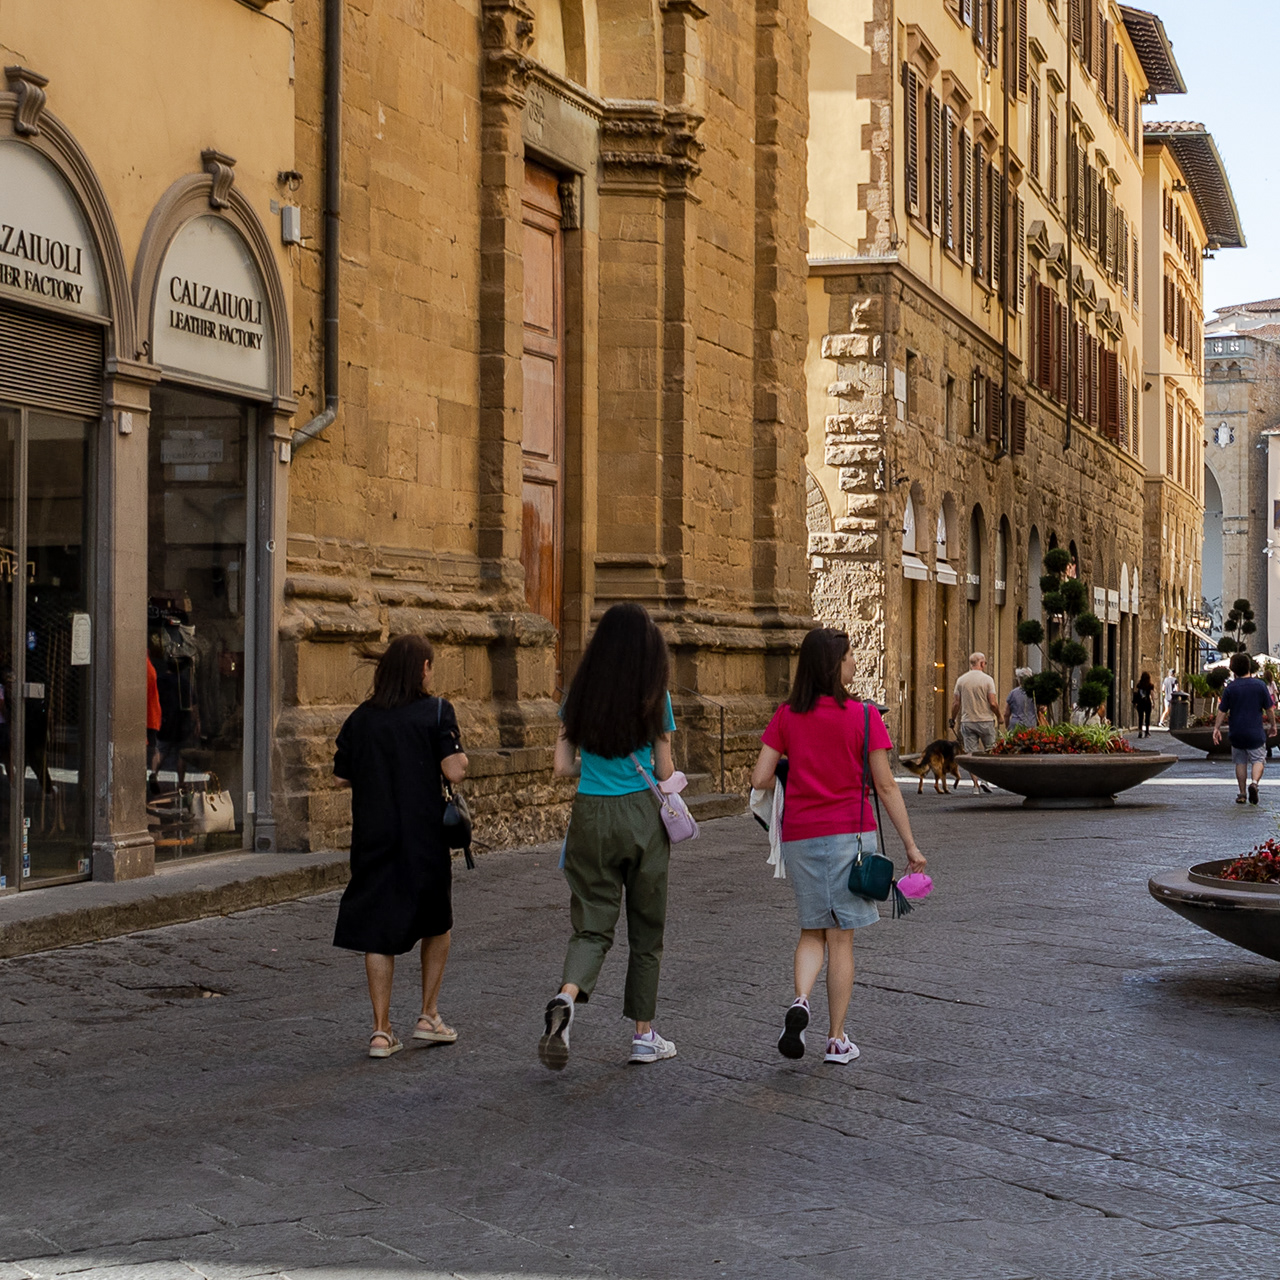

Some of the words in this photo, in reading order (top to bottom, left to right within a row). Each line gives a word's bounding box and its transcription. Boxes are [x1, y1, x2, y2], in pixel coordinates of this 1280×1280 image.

[24, 270, 84, 304] FACTORY
[169, 276, 262, 325] CALZAIUOLI
[169, 309, 217, 339] LEATHER
[218, 323, 263, 350] FACTORY
